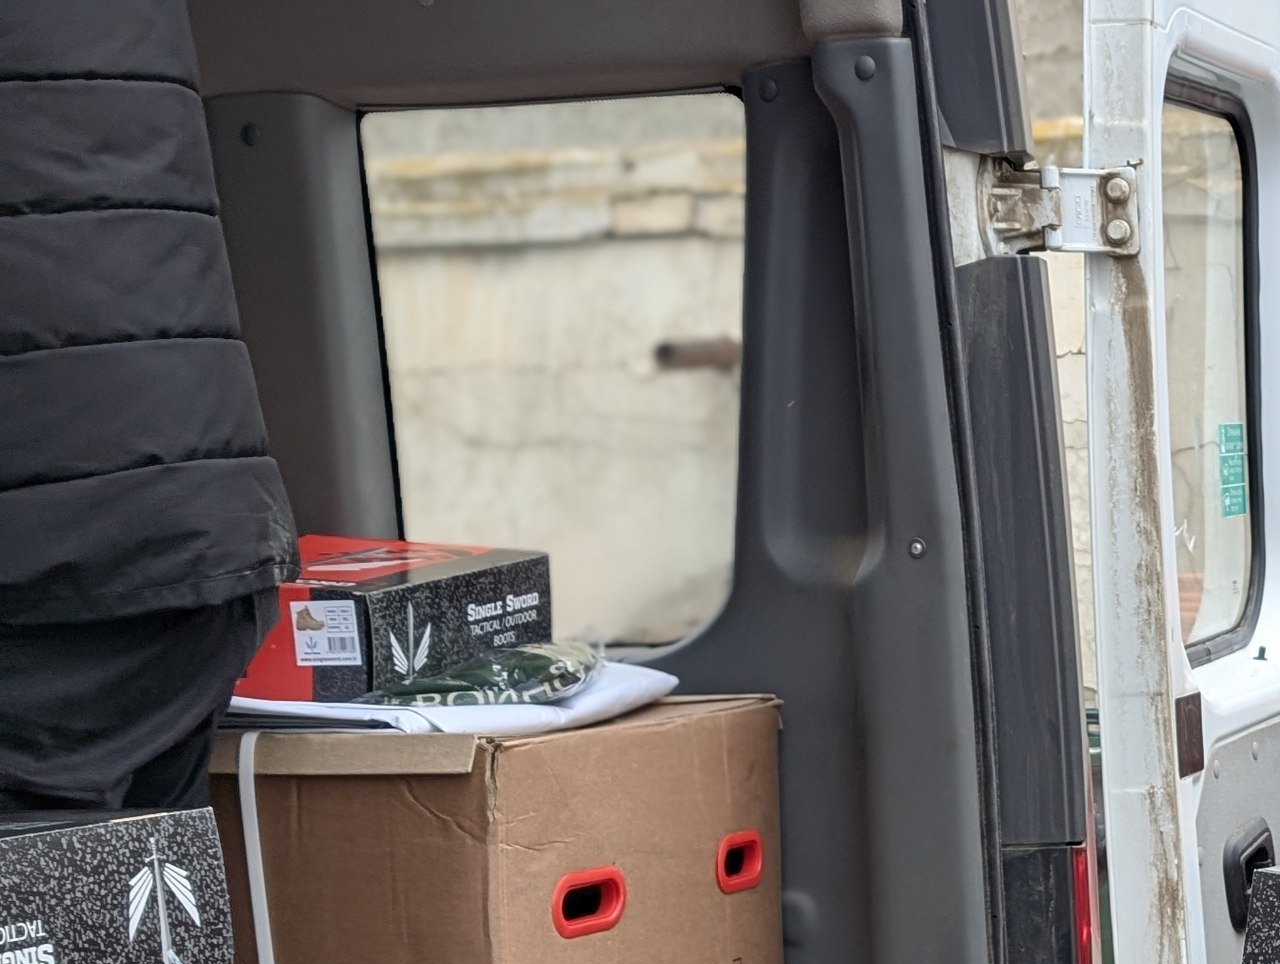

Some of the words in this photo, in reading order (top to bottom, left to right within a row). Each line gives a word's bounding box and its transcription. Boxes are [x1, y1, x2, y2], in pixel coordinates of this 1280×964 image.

[467, 601, 502, 621] SINGLE
[506, 592, 539, 612] SWORD
[470, 619, 501, 635] TACTICAL
[505, 609, 537, 628] OUTDOOR
[493, 631, 515, 647] BOOTS
